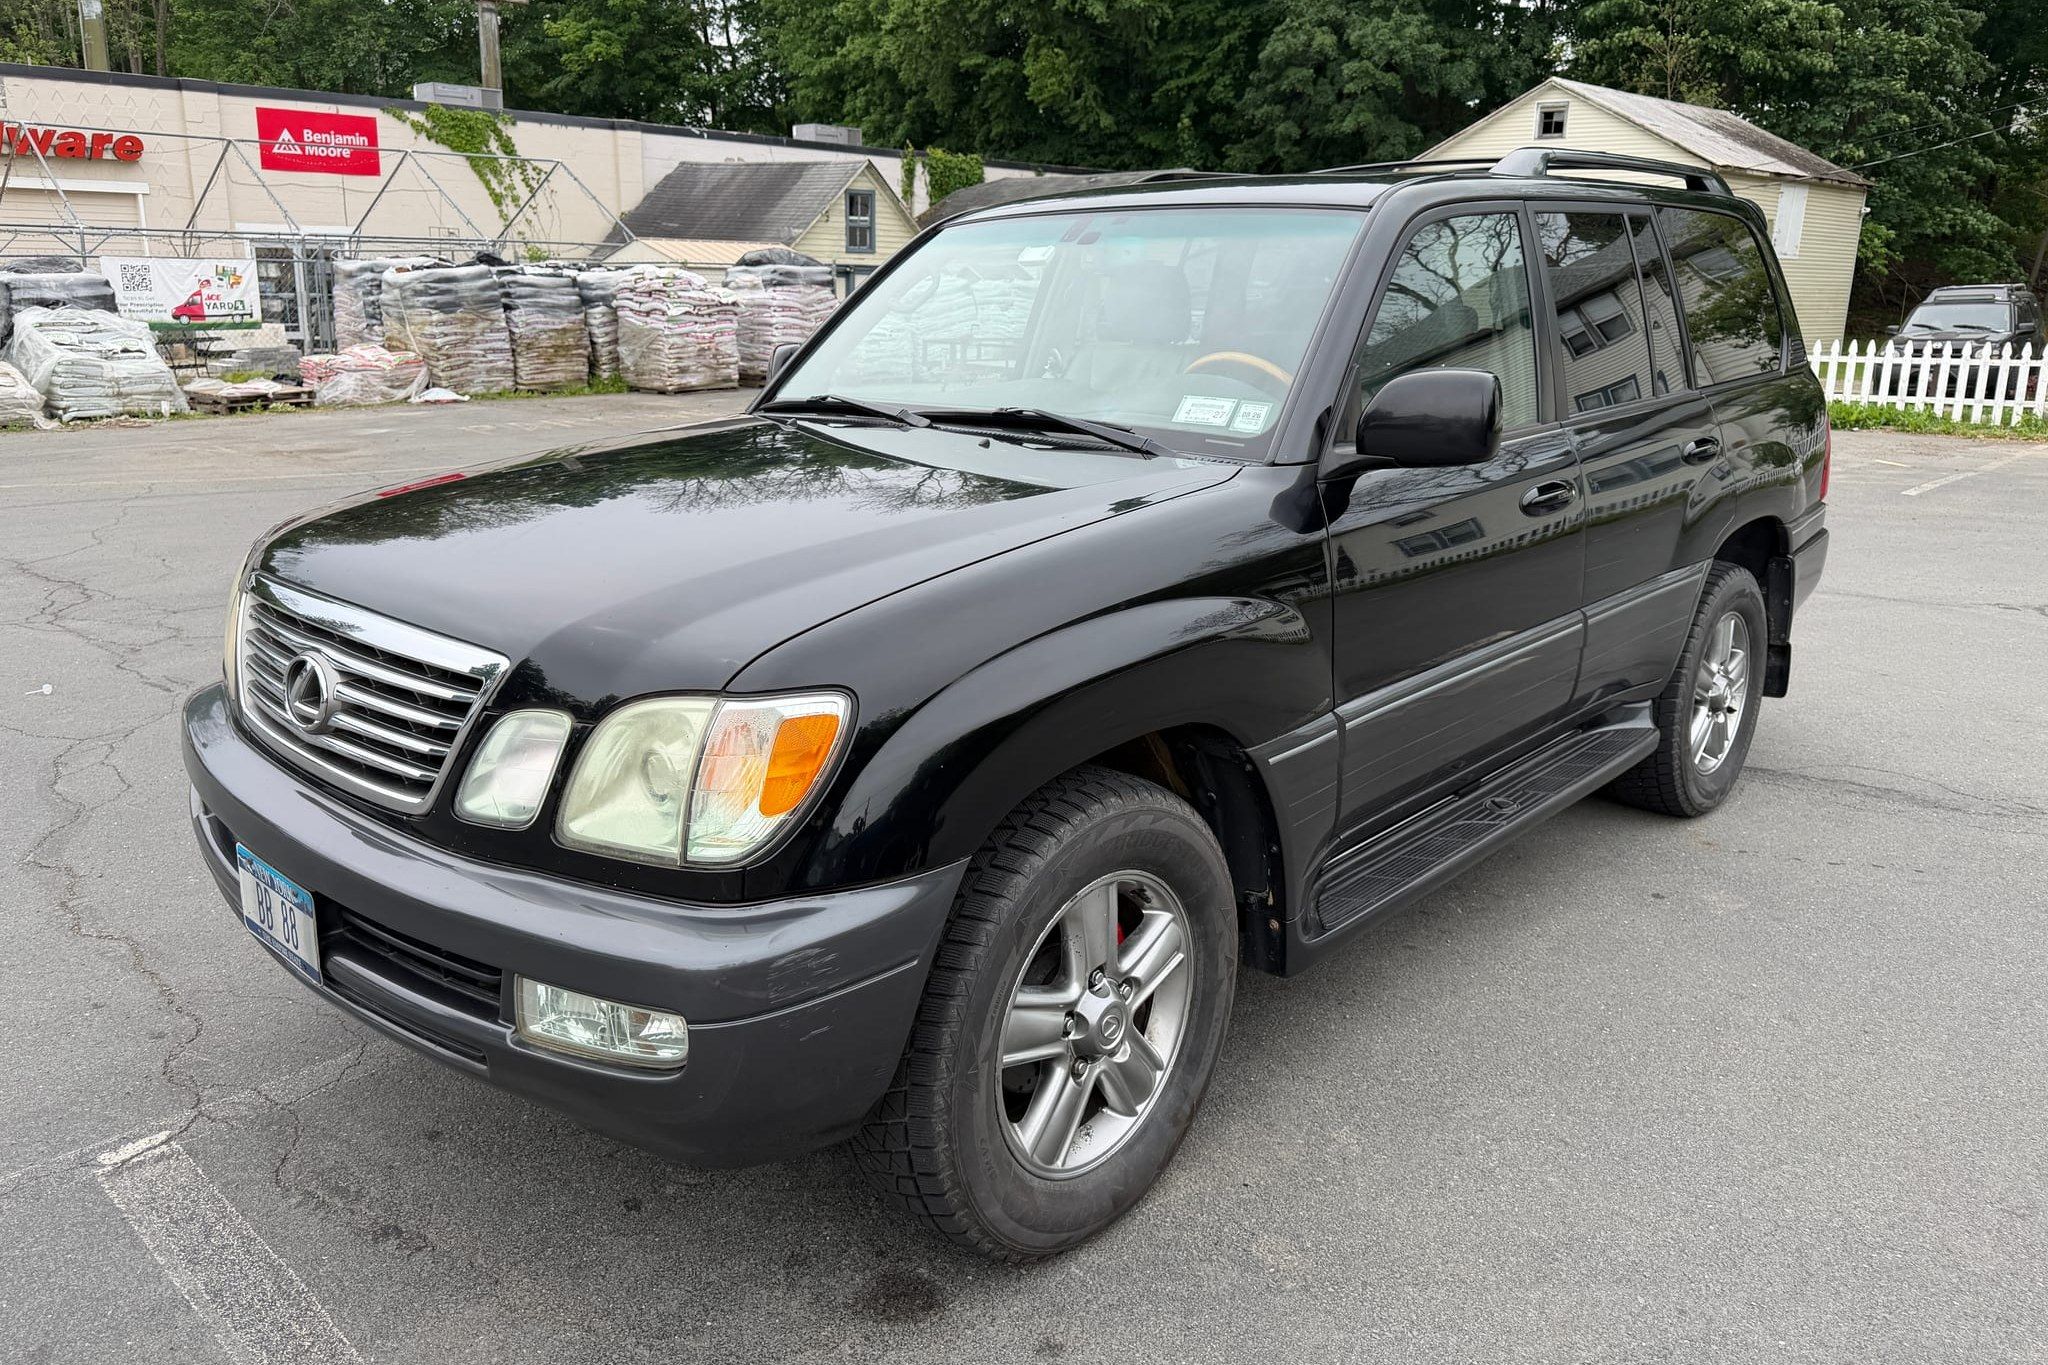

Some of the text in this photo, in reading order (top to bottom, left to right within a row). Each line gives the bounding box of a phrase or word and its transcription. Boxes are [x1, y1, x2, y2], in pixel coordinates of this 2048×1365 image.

[303, 128, 368, 147] Benjamin
[305, 144, 351, 158] Moore
[255, 861, 296, 904] NEW YORK
[256, 881, 299, 951] BB 88
